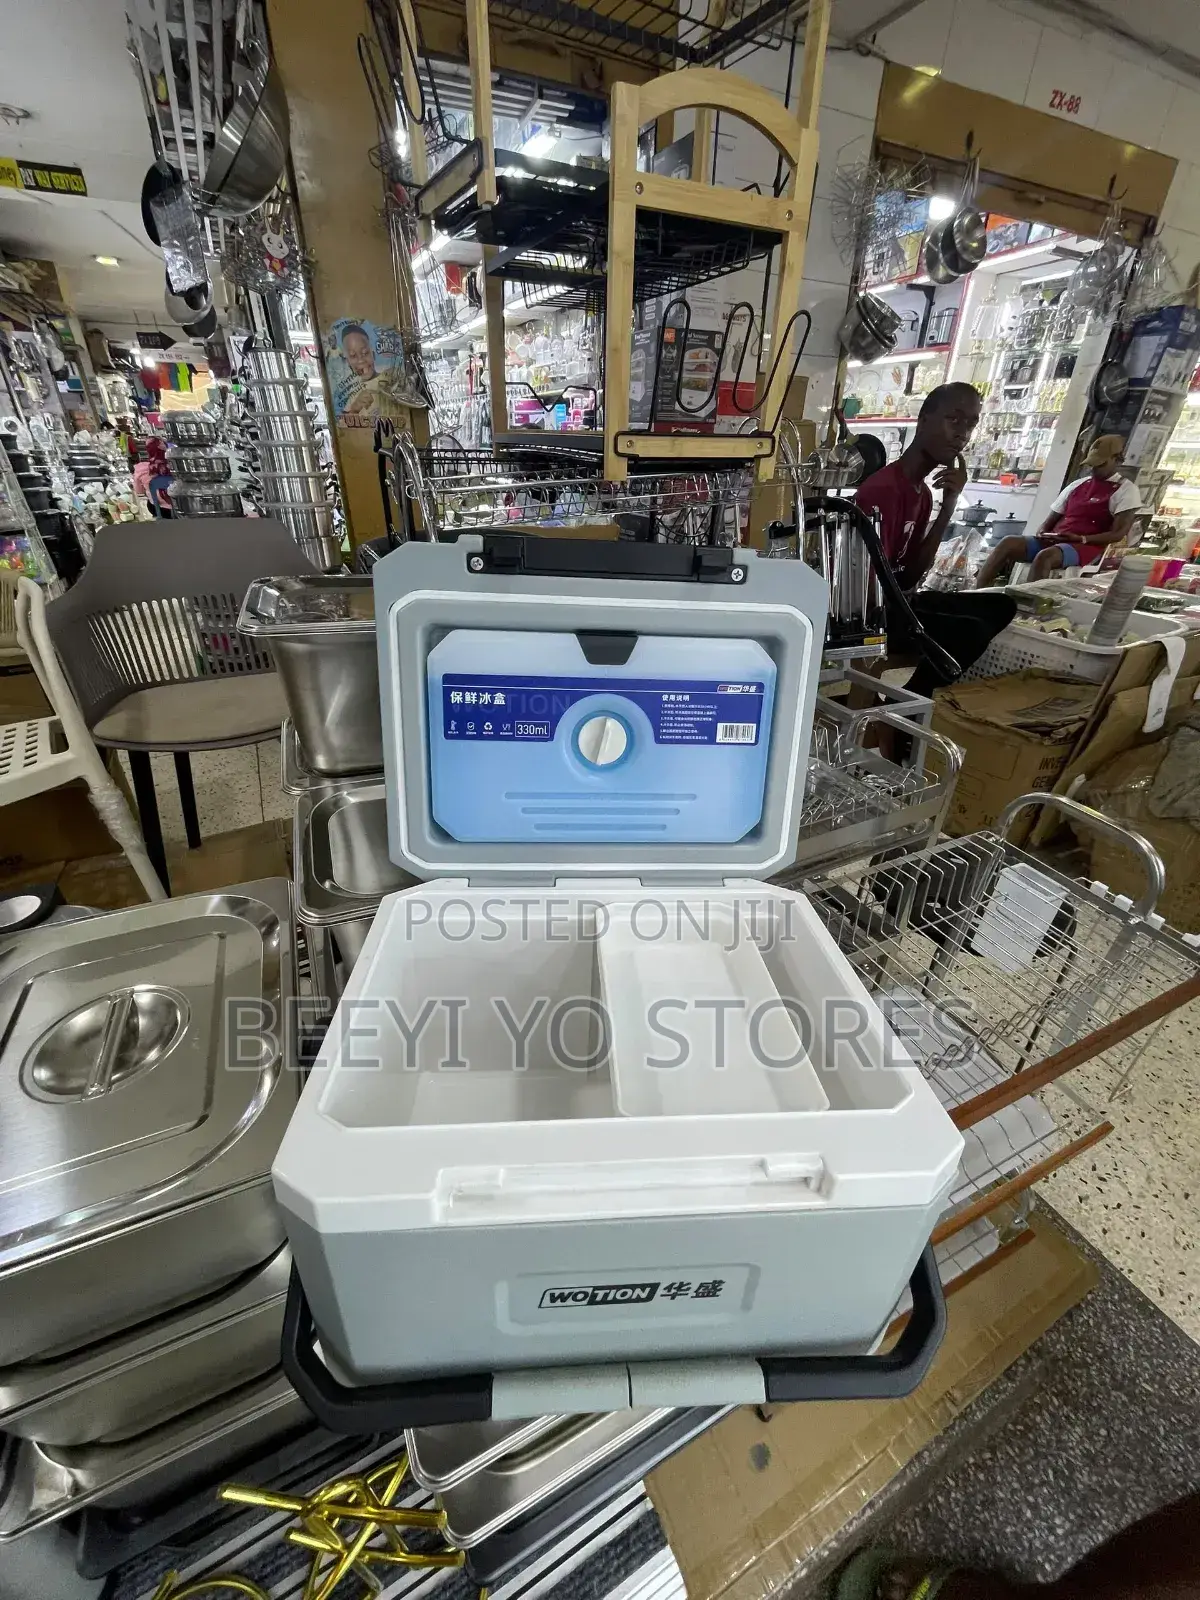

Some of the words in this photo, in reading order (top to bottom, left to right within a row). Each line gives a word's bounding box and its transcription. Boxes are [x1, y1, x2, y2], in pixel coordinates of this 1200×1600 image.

[450, 691, 506, 705] 保鲜冰盒
[662, 694, 690, 702] 使用说明
[517, 724, 548, 735] 330ml
[546, 1286, 653, 1304] WOTION
[660, 1279, 726, 1300] 华盛
